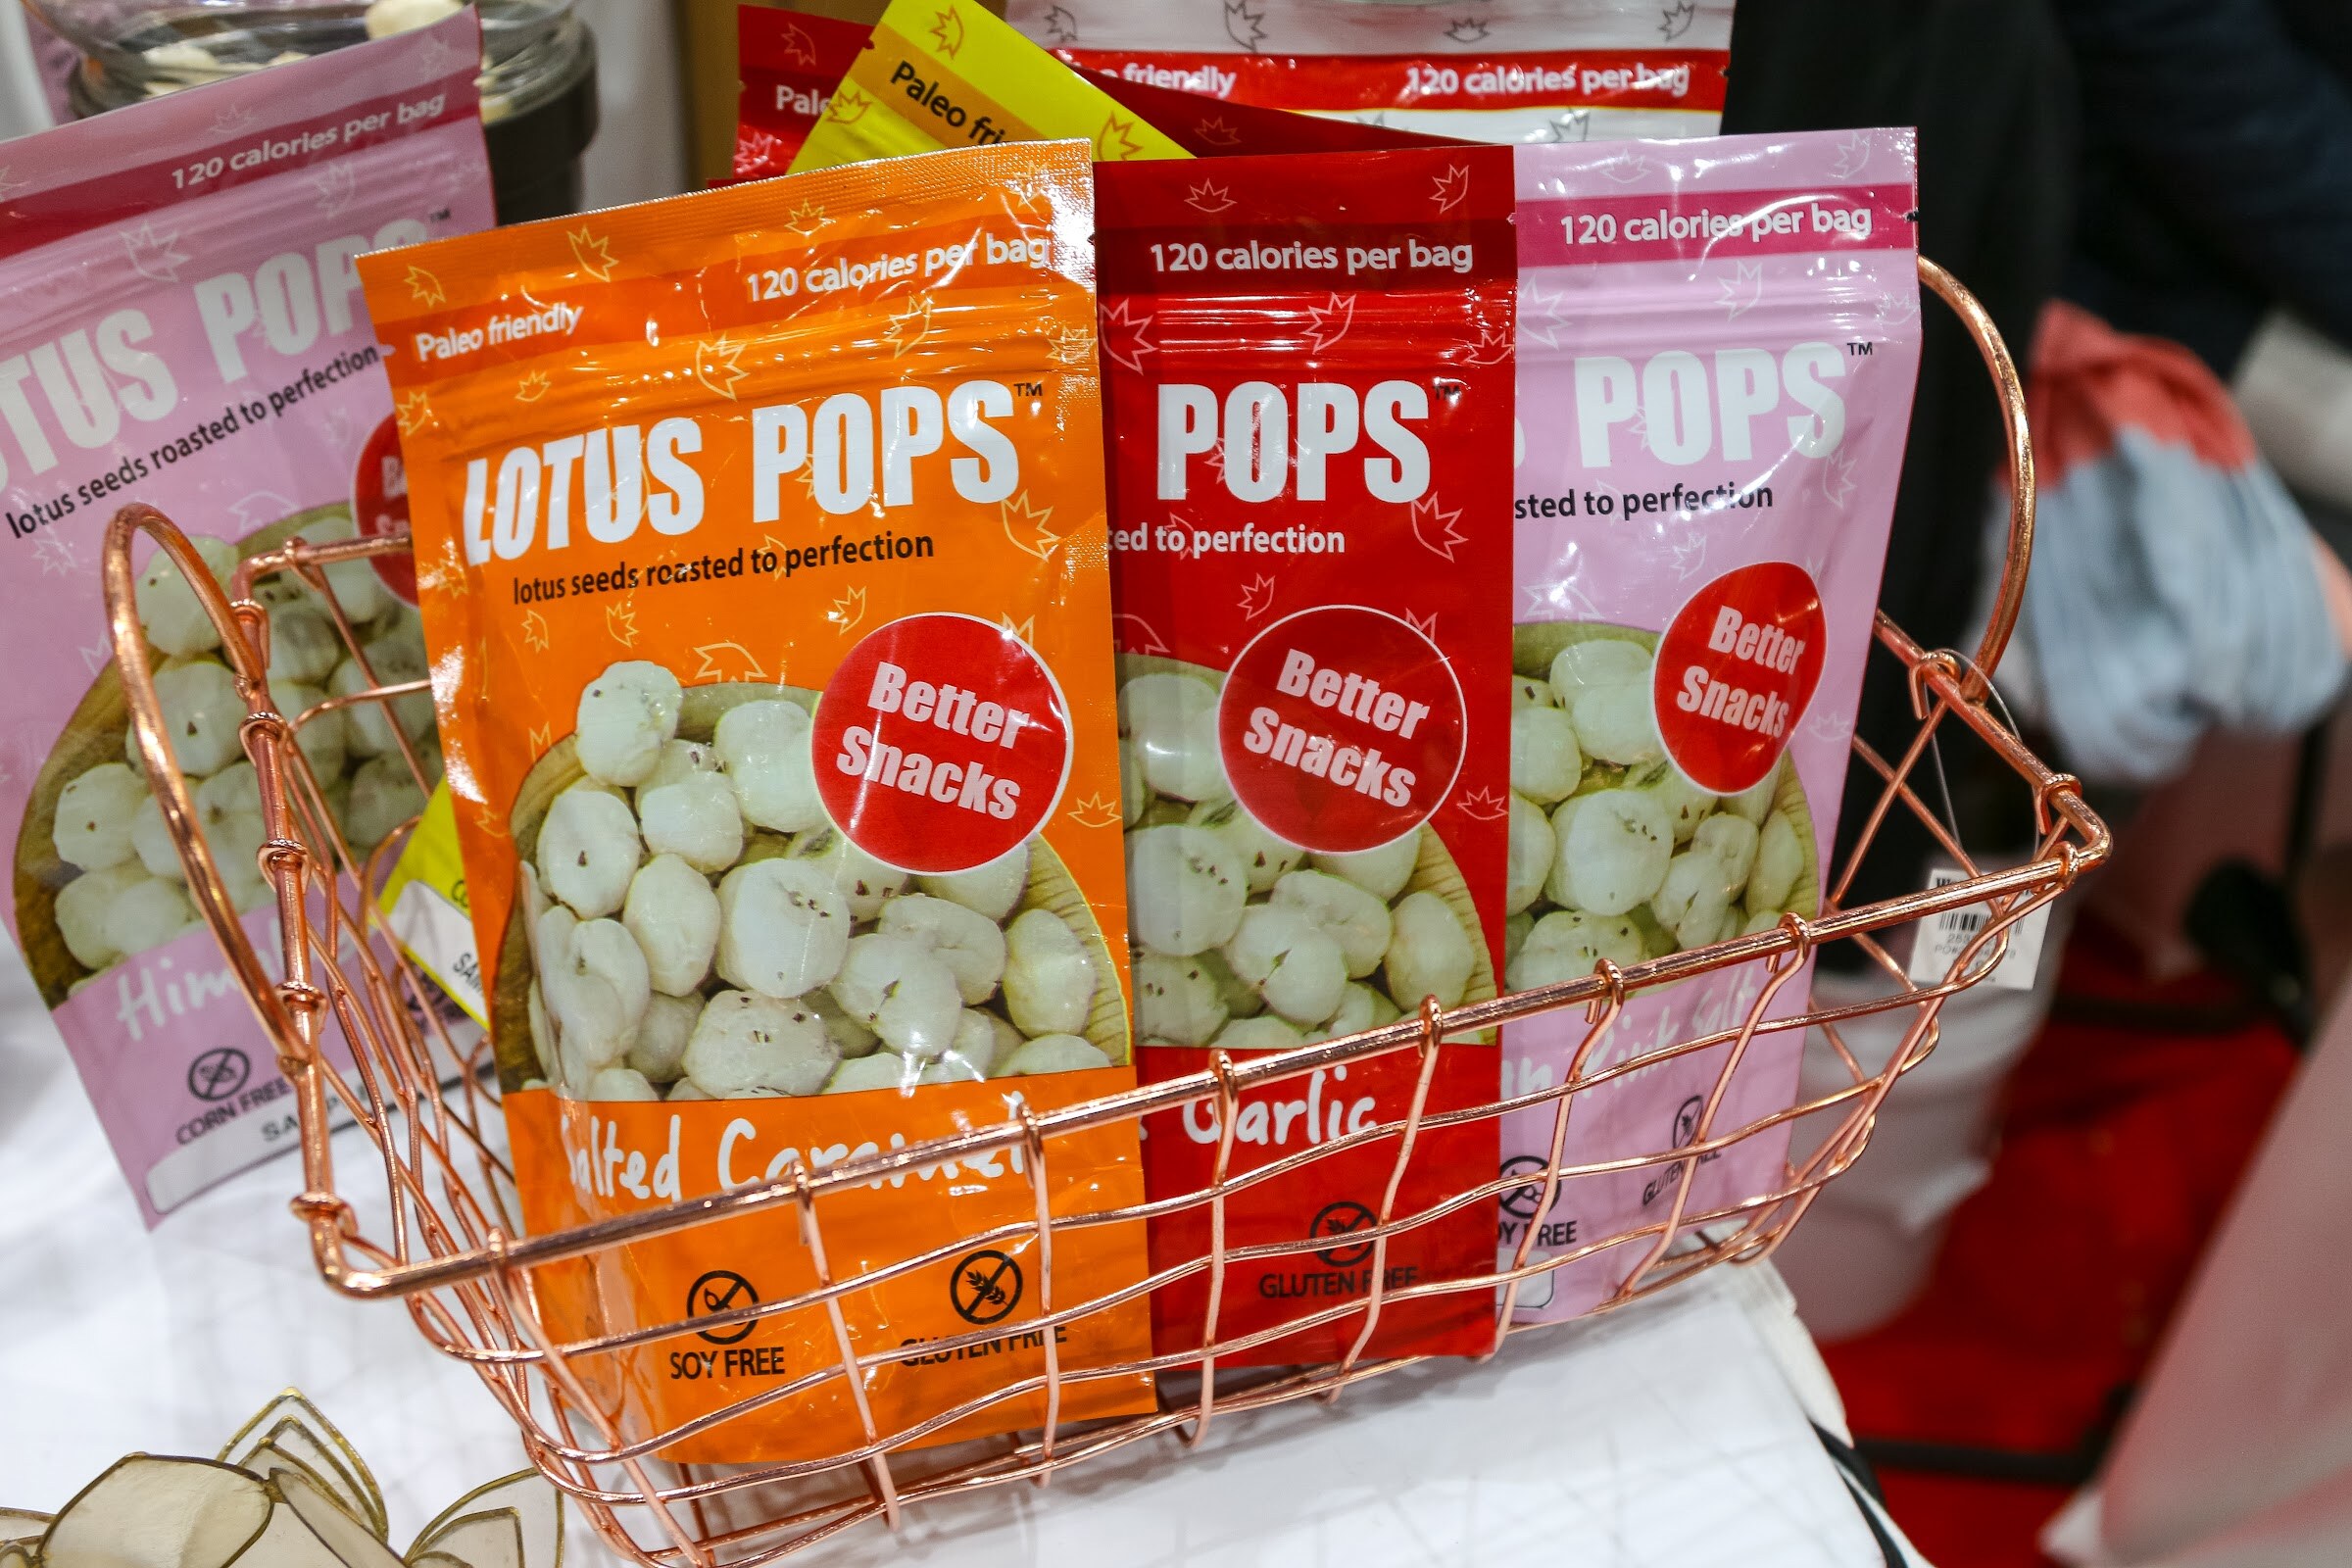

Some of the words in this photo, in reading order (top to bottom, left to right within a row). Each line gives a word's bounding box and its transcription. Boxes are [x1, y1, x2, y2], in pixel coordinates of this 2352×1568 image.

[890, 60, 966, 127] Paleo
[1406, 66, 1459, 96] 120
[1465, 66, 1576, 94] calories
[1581, 67, 1633, 95] per
[1635, 63, 1690, 97] bag
[172, 157, 223, 188] 120
[229, 126, 338, 172] calories
[344, 111, 391, 142] per
[397, 94, 446, 123] bag
[1151, 242, 1207, 272] 120
[1215, 240, 1338, 270] calories
[1346, 244, 1401, 275] per
[1408, 238, 1473, 272] bag
[1561, 215, 1617, 245] 120
[1624, 209, 1743, 242] calories
[1751, 210, 1805, 243] per
[1811, 203, 1873, 237] bag
[747, 267, 799, 302] 120
[805, 252, 917, 292] calories
[924, 240, 978, 277] per
[986, 232, 1050, 269] bag
[0, 309, 179, 490] TUS
[193, 219, 428, 383] POP
[416, 327, 484, 362] Paleo
[488, 302, 584, 345] friendly
[1574, 342, 1846, 468] POPS
[6, 492, 75, 538] lotus
[78, 457, 149, 506] seeds
[150, 408, 241, 470] roasted
[241, 399, 268, 424] to
[268, 344, 380, 417] perfection
[463, 416, 705, 566] LOTUS
[752, 379, 1019, 522] POPS
[1156, 379, 1431, 504] POPS
[1584, 491, 1614, 516] to
[1623, 481, 1773, 521] perfection
[513, 575, 565, 606] lotus
[571, 561, 638, 595] seeds
[647, 547, 744, 588] roasted
[751, 547, 777, 573] to
[786, 530, 934, 578] perfection
[1154, 525, 1186, 552] to
[1193, 522, 1346, 560] perfection
[1708, 605, 1806, 675] Better
[867, 661, 1030, 750] Better
[1276, 648, 1431, 740] Better
[1676, 665, 1789, 738] Snacks
[836, 725, 1021, 820] Snacks
[1243, 707, 1417, 808] Snacks
[176, 1102, 237, 1145] CORN
[1258, 1271, 1355, 1298] GLUTEN
[670, 1350, 718, 1380] SOY
[725, 1346, 785, 1378] FREE
